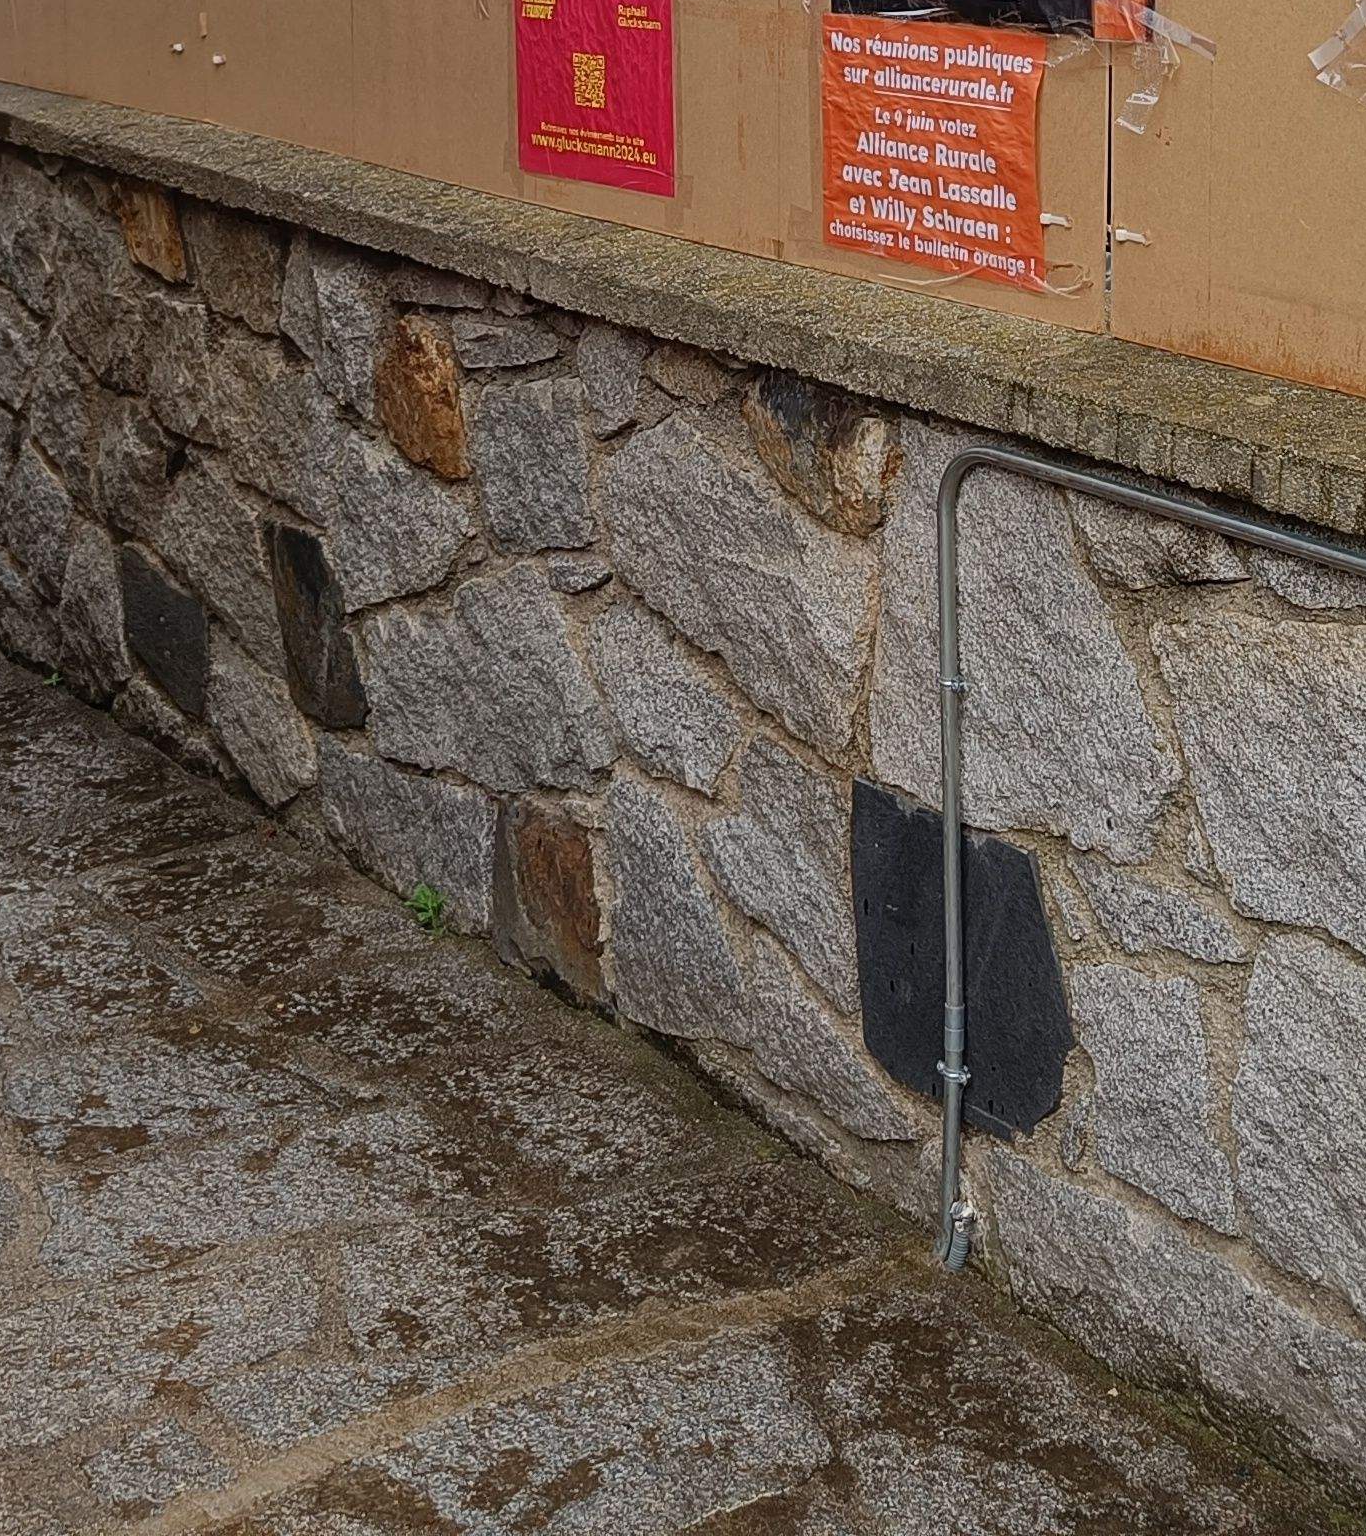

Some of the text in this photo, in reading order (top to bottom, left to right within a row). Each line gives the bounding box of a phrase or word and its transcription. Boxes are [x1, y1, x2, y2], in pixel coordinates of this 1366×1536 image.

[617, 4, 648, 18] Raphaël
[831, 31, 1034, 76] Nos réunions publiques
[843, 65, 1015, 104] sur alliancerurale.fr
[875, 107, 977, 138] Le 9 juin votez
[531, 133, 657, 165] www.glucksmann2024.eu
[856, 131, 997, 175] Alliance Rurale
[842, 164, 1017, 212] avec Jean Lassalle
[849, 195, 866, 215] et
[870, 196, 917, 231] Willy
[922, 205, 999, 242] Schraen
[829, 219, 894, 247] choisissez
[898, 232, 911, 251] le
[914, 234, 969, 262] bulletin
[973, 250, 1026, 277] orange
